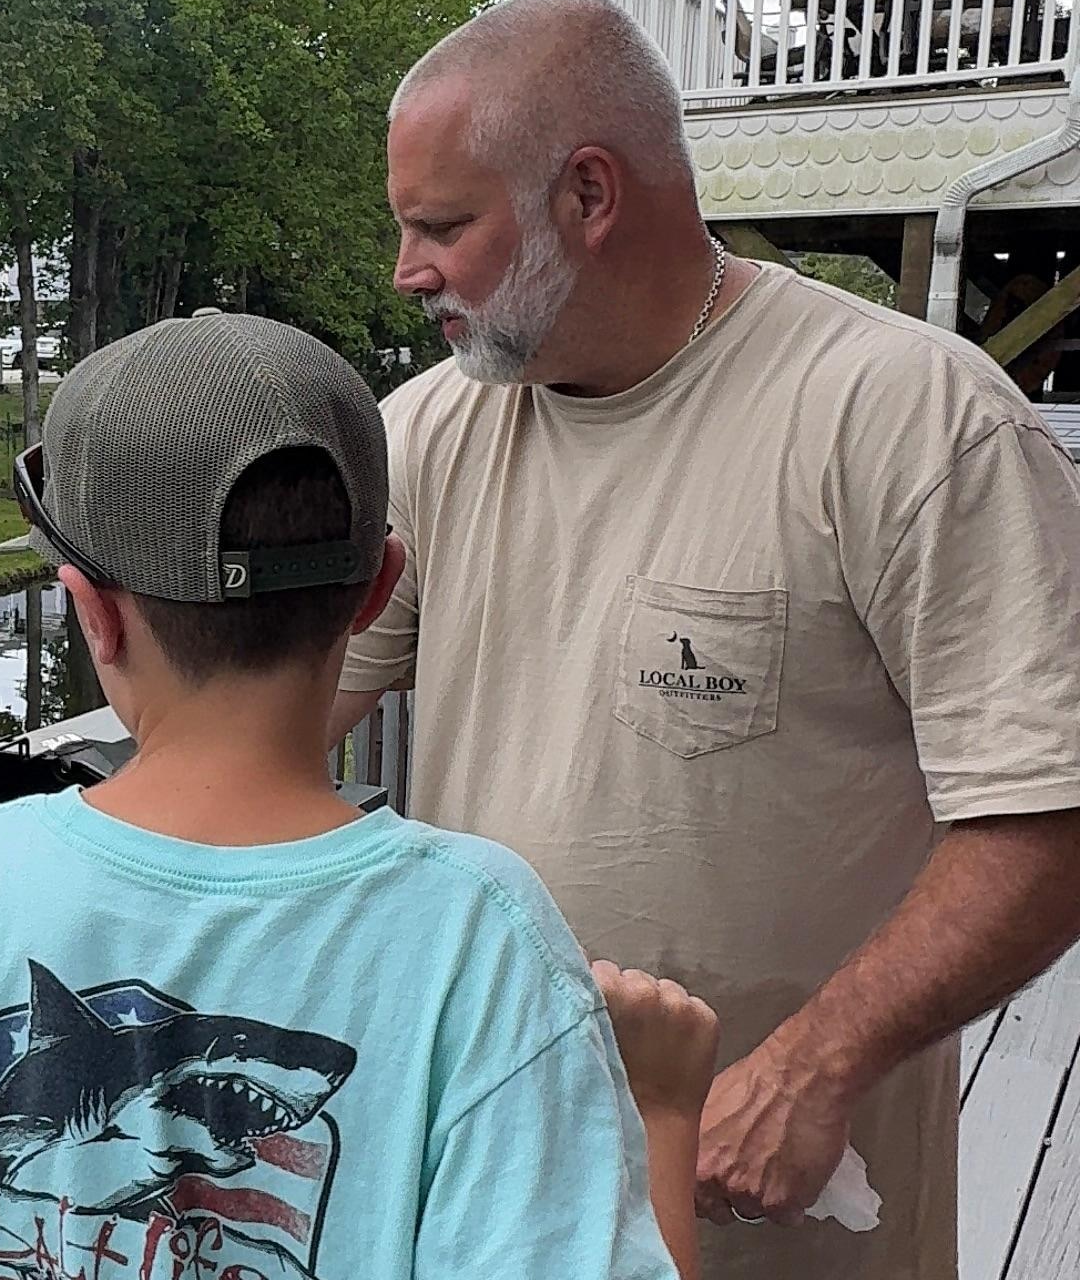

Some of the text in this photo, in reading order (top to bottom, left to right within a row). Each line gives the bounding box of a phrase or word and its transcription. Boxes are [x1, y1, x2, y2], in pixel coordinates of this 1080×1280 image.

[639, 669, 747, 690] LOCAL BOY
[659, 690, 722, 701] OUTFITTERS
